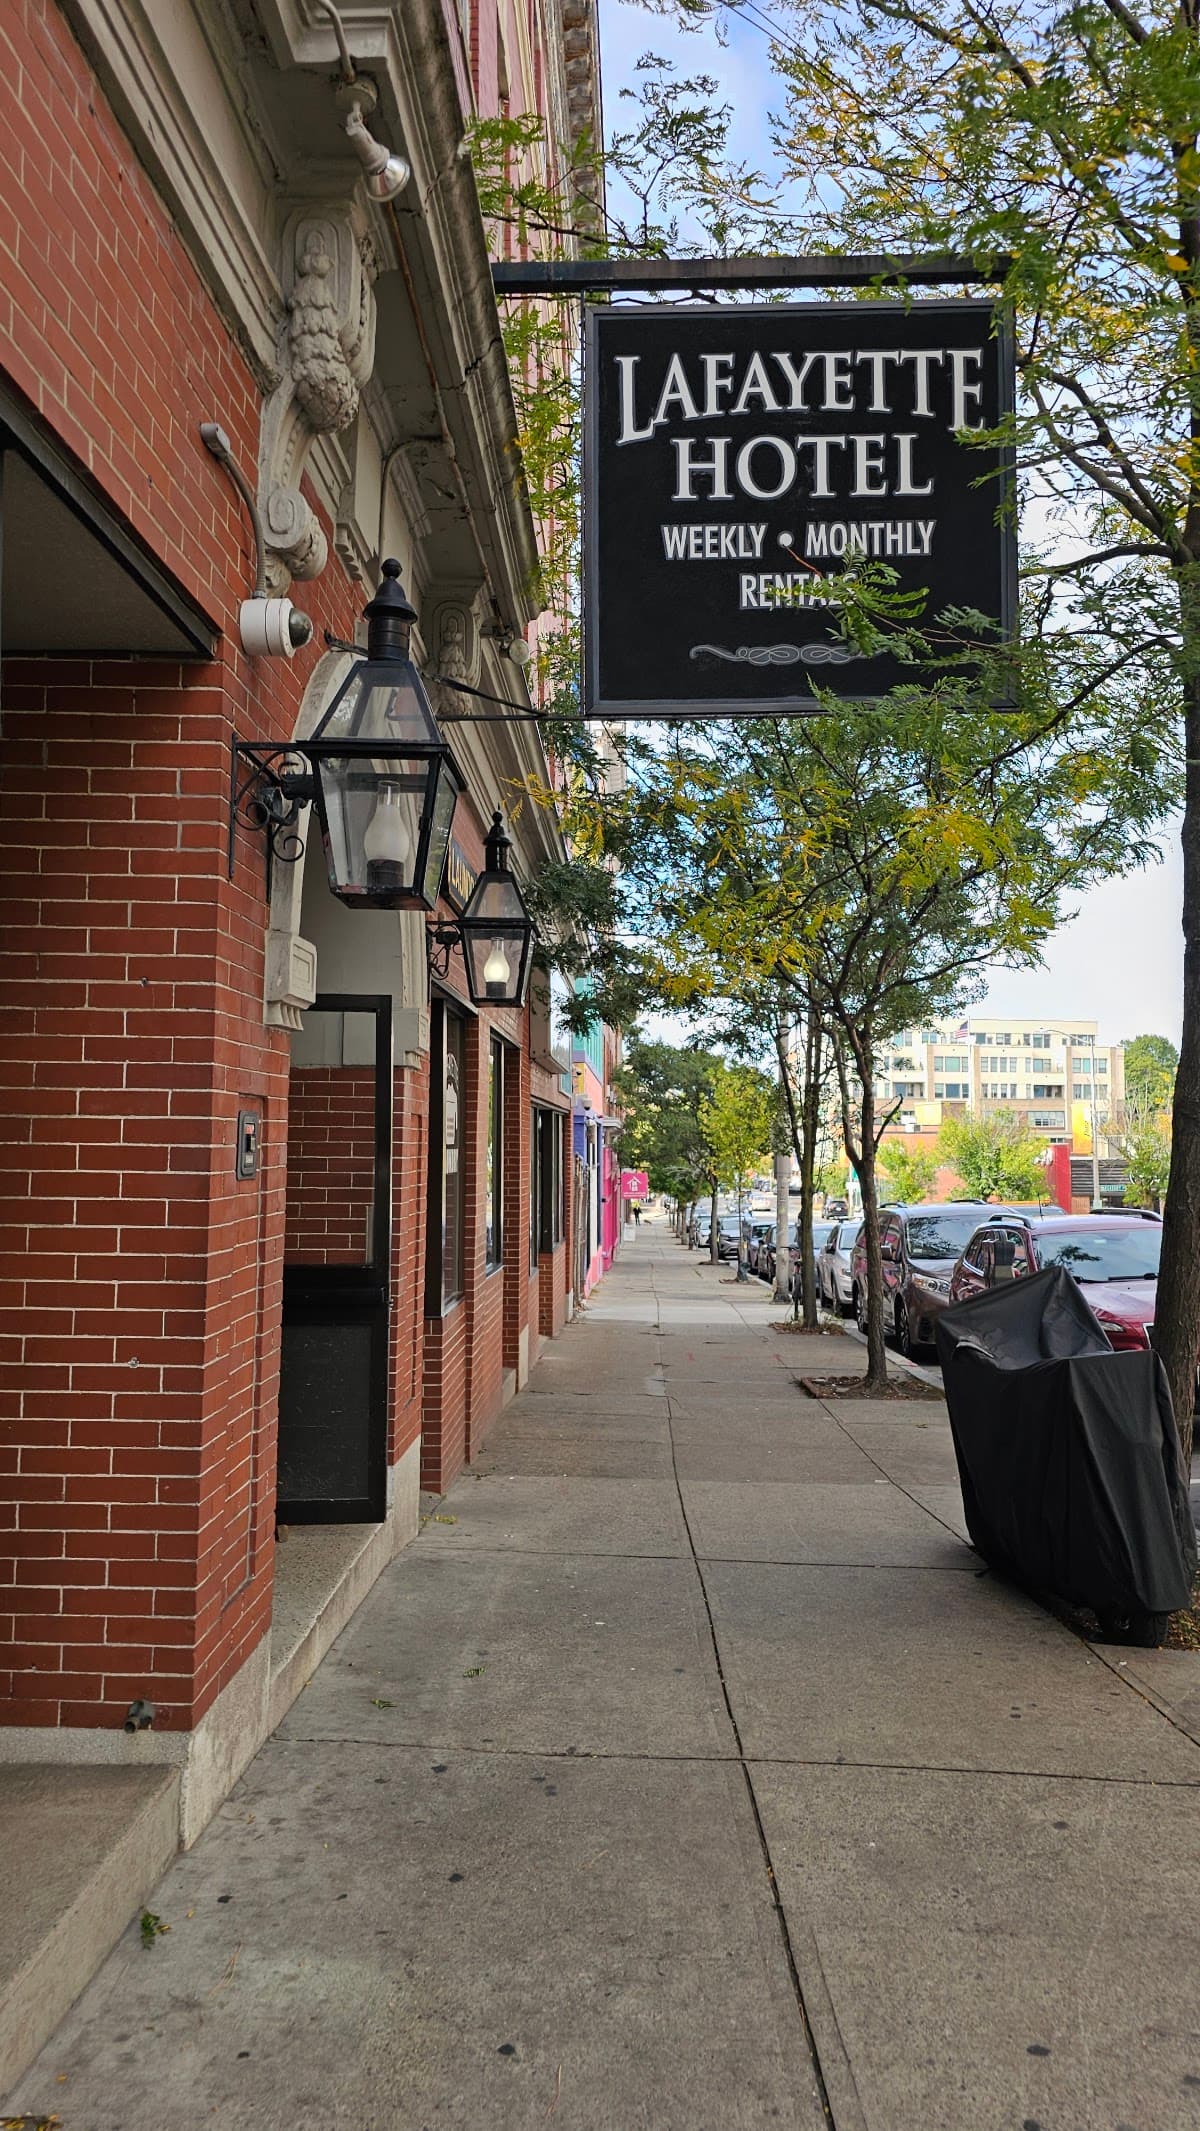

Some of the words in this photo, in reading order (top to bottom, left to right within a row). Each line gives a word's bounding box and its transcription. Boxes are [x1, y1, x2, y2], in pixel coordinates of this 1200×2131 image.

[614, 350, 984, 445] LAFAYETTE
[670, 433, 934, 501] HOTEL
[662, 524, 767, 560] WEEKLY
[806, 520, 936, 557] MONTHLY
